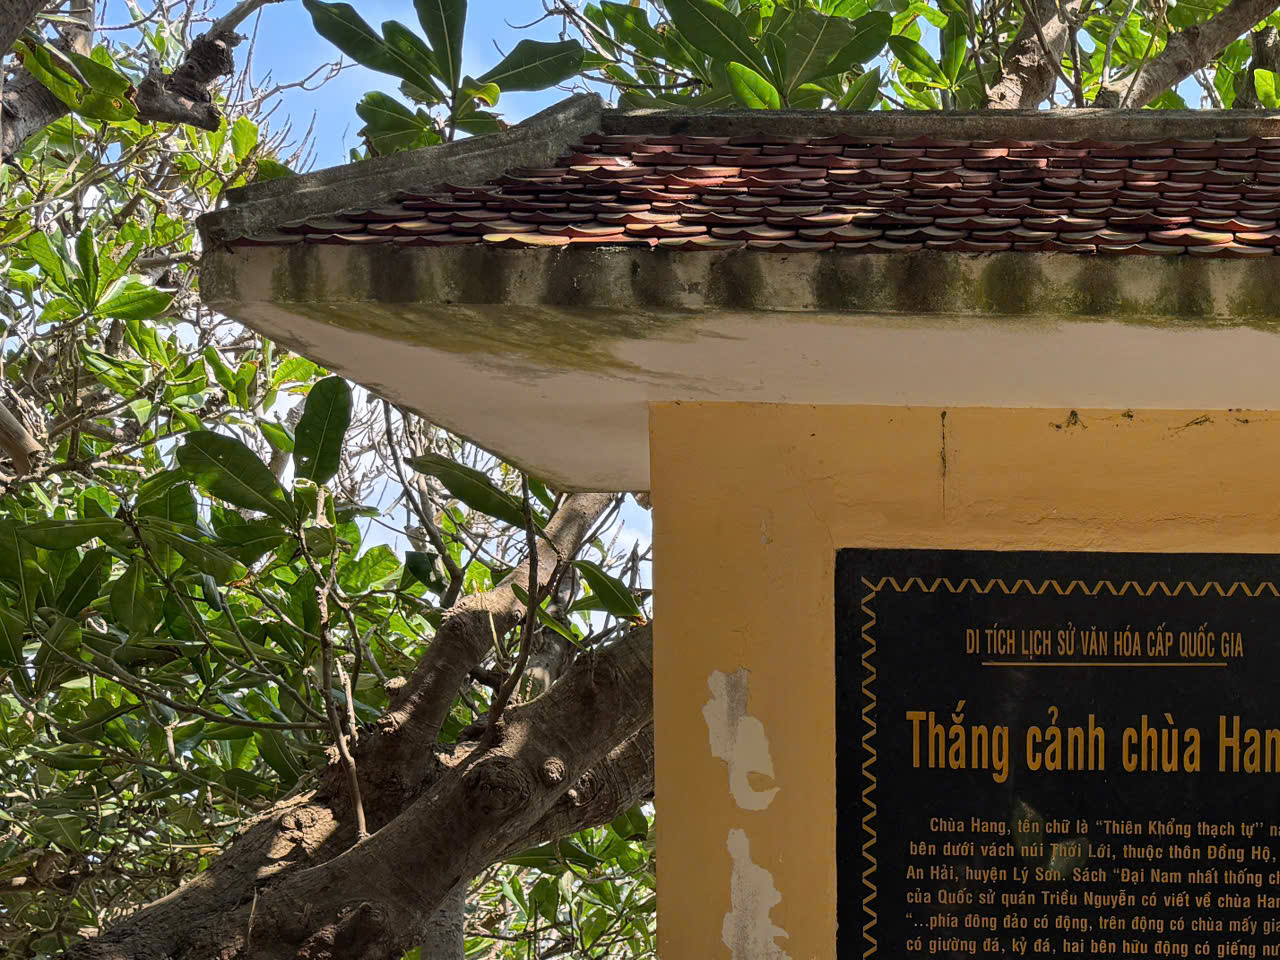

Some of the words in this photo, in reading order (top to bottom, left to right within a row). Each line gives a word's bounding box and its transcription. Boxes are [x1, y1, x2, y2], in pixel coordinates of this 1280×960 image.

[965, 628, 980, 655] DI
[984, 622, 1015, 656] TÍCH
[1021, 629, 1051, 661] LỊCH
[1057, 622, 1077, 657] SỬ
[1078, 625, 1108, 657] VĂN
[1113, 624, 1141, 657] HÓA
[1146, 621, 1174, 657] CẤP
[1178, 622, 1215, 658] QUỐC
[1220, 631, 1244, 658] GIA
[905, 699, 1009, 785] Thắng
[1025, 705, 1105, 772] cảnh
[1121, 712, 1201, 774] chùa
[929, 816, 964, 833] Chùa
[970, 816, 1010, 836] Hang,
[1017, 819, 1040, 833] tên
[1045, 819, 1070, 834] chữ
[1075, 819, 1088, 834] là
[1147, 817, 1191, 839] Khổng
[1196, 821, 1236, 838] thạch
[909, 840, 936, 856] bên
[942, 841, 974, 857] dưới
[979, 842, 1014, 857] vách
[1020, 842, 1043, 857] núi
[1087, 842, 1116, 861] Lới,
[1122, 844, 1163, 861] thuộc
[1168, 844, 1200, 860] thôn
[1207, 843, 1245, 863] Đồng
[1250, 845, 1276, 863] Hộ,
[905, 865, 924, 880] An
[929, 864, 959, 882] Hải,
[964, 865, 1008, 884] huyện
[1012, 866, 1028, 884] Lý
[1034, 866, 1065, 881] Sơn.
[1072, 867, 1107, 882] Sách
[1150, 868, 1183, 884] Nam
[1187, 867, 1218, 884] nhất
[1223, 868, 1263, 888] thống
[906, 887, 931, 904] của
[937, 887, 973, 905] Quốc
[978, 888, 995, 905] sử
[1000, 890, 1035, 908] quán
[1041, 889, 1077, 906] Triều
[1083, 889, 1136, 909] Nguyễn
[1141, 891, 1157, 907] có
[1162, 890, 1190, 908] viết
[1194, 891, 1211, 908] về
[1217, 893, 1252, 909] chùa
